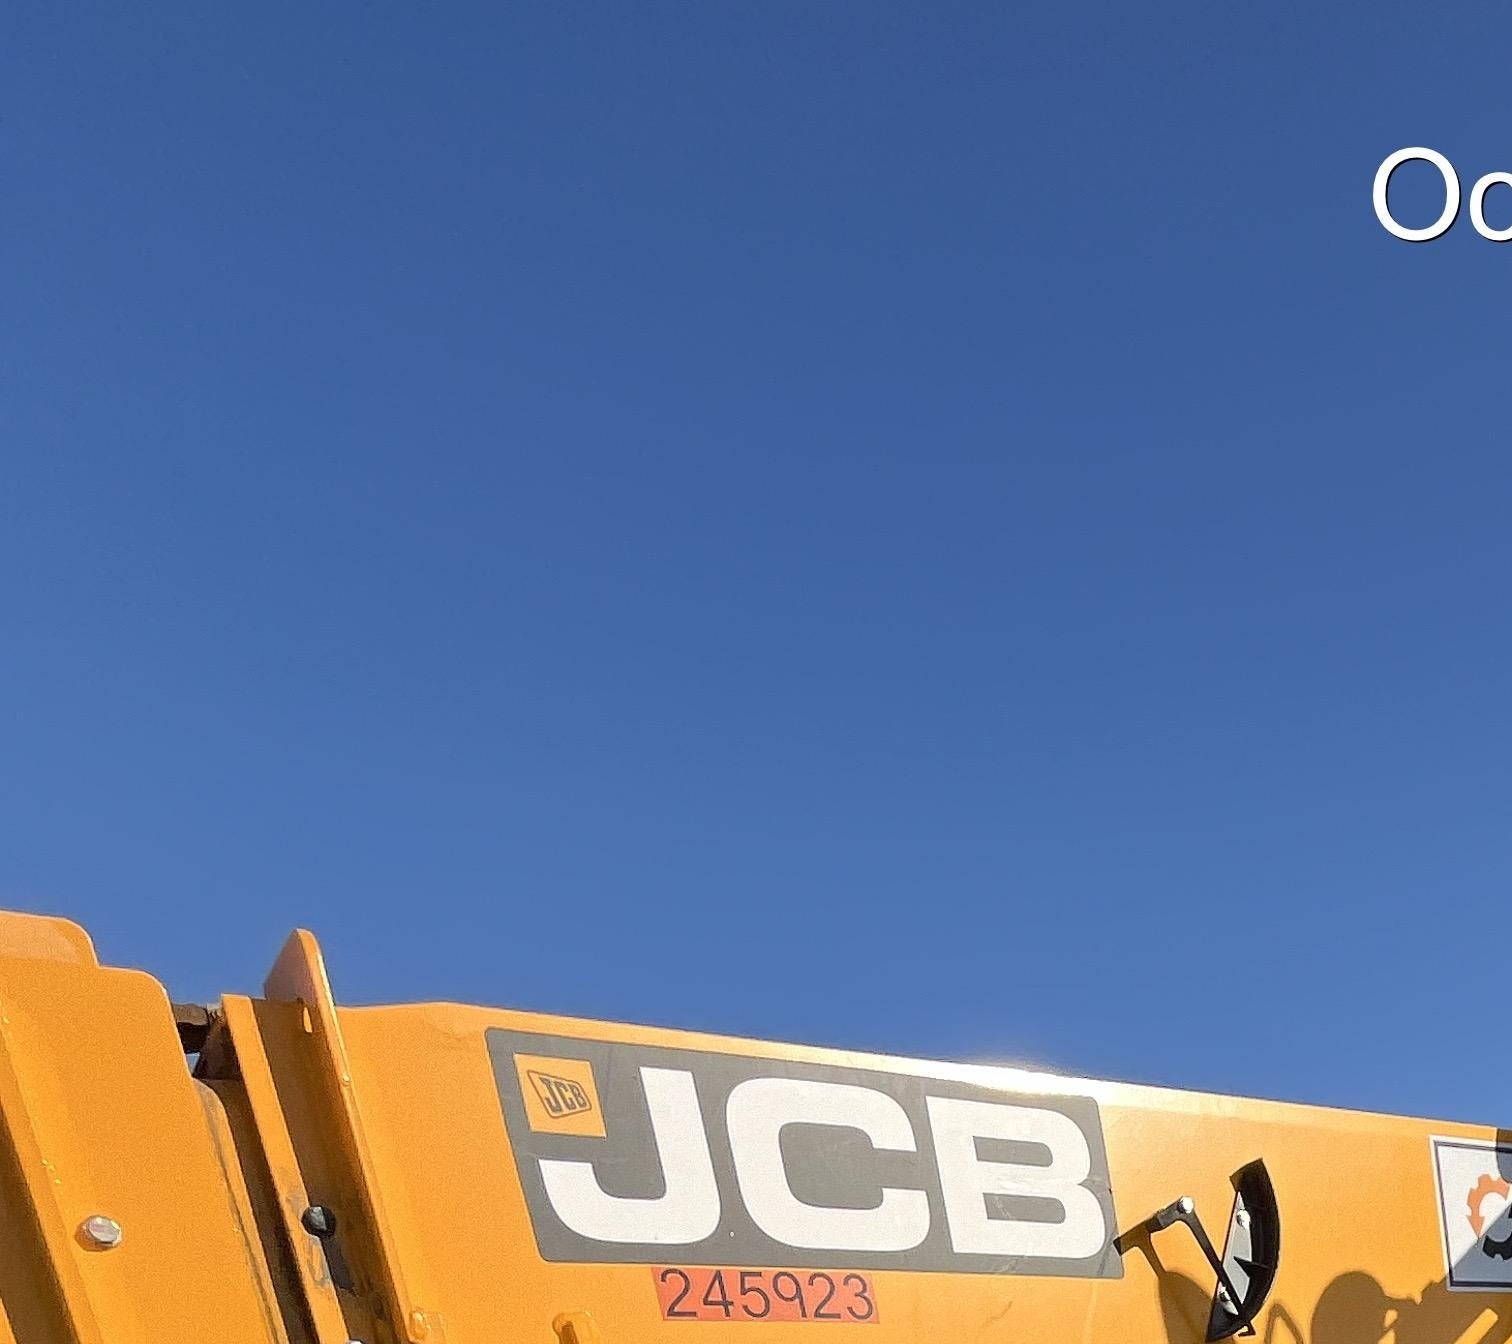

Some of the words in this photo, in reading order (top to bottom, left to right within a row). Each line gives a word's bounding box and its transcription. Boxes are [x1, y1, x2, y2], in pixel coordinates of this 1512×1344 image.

[538, 1075, 588, 1113] JCB
[537, 1065, 1107, 1260] JCB
[658, 1267, 876, 1322] 245923
